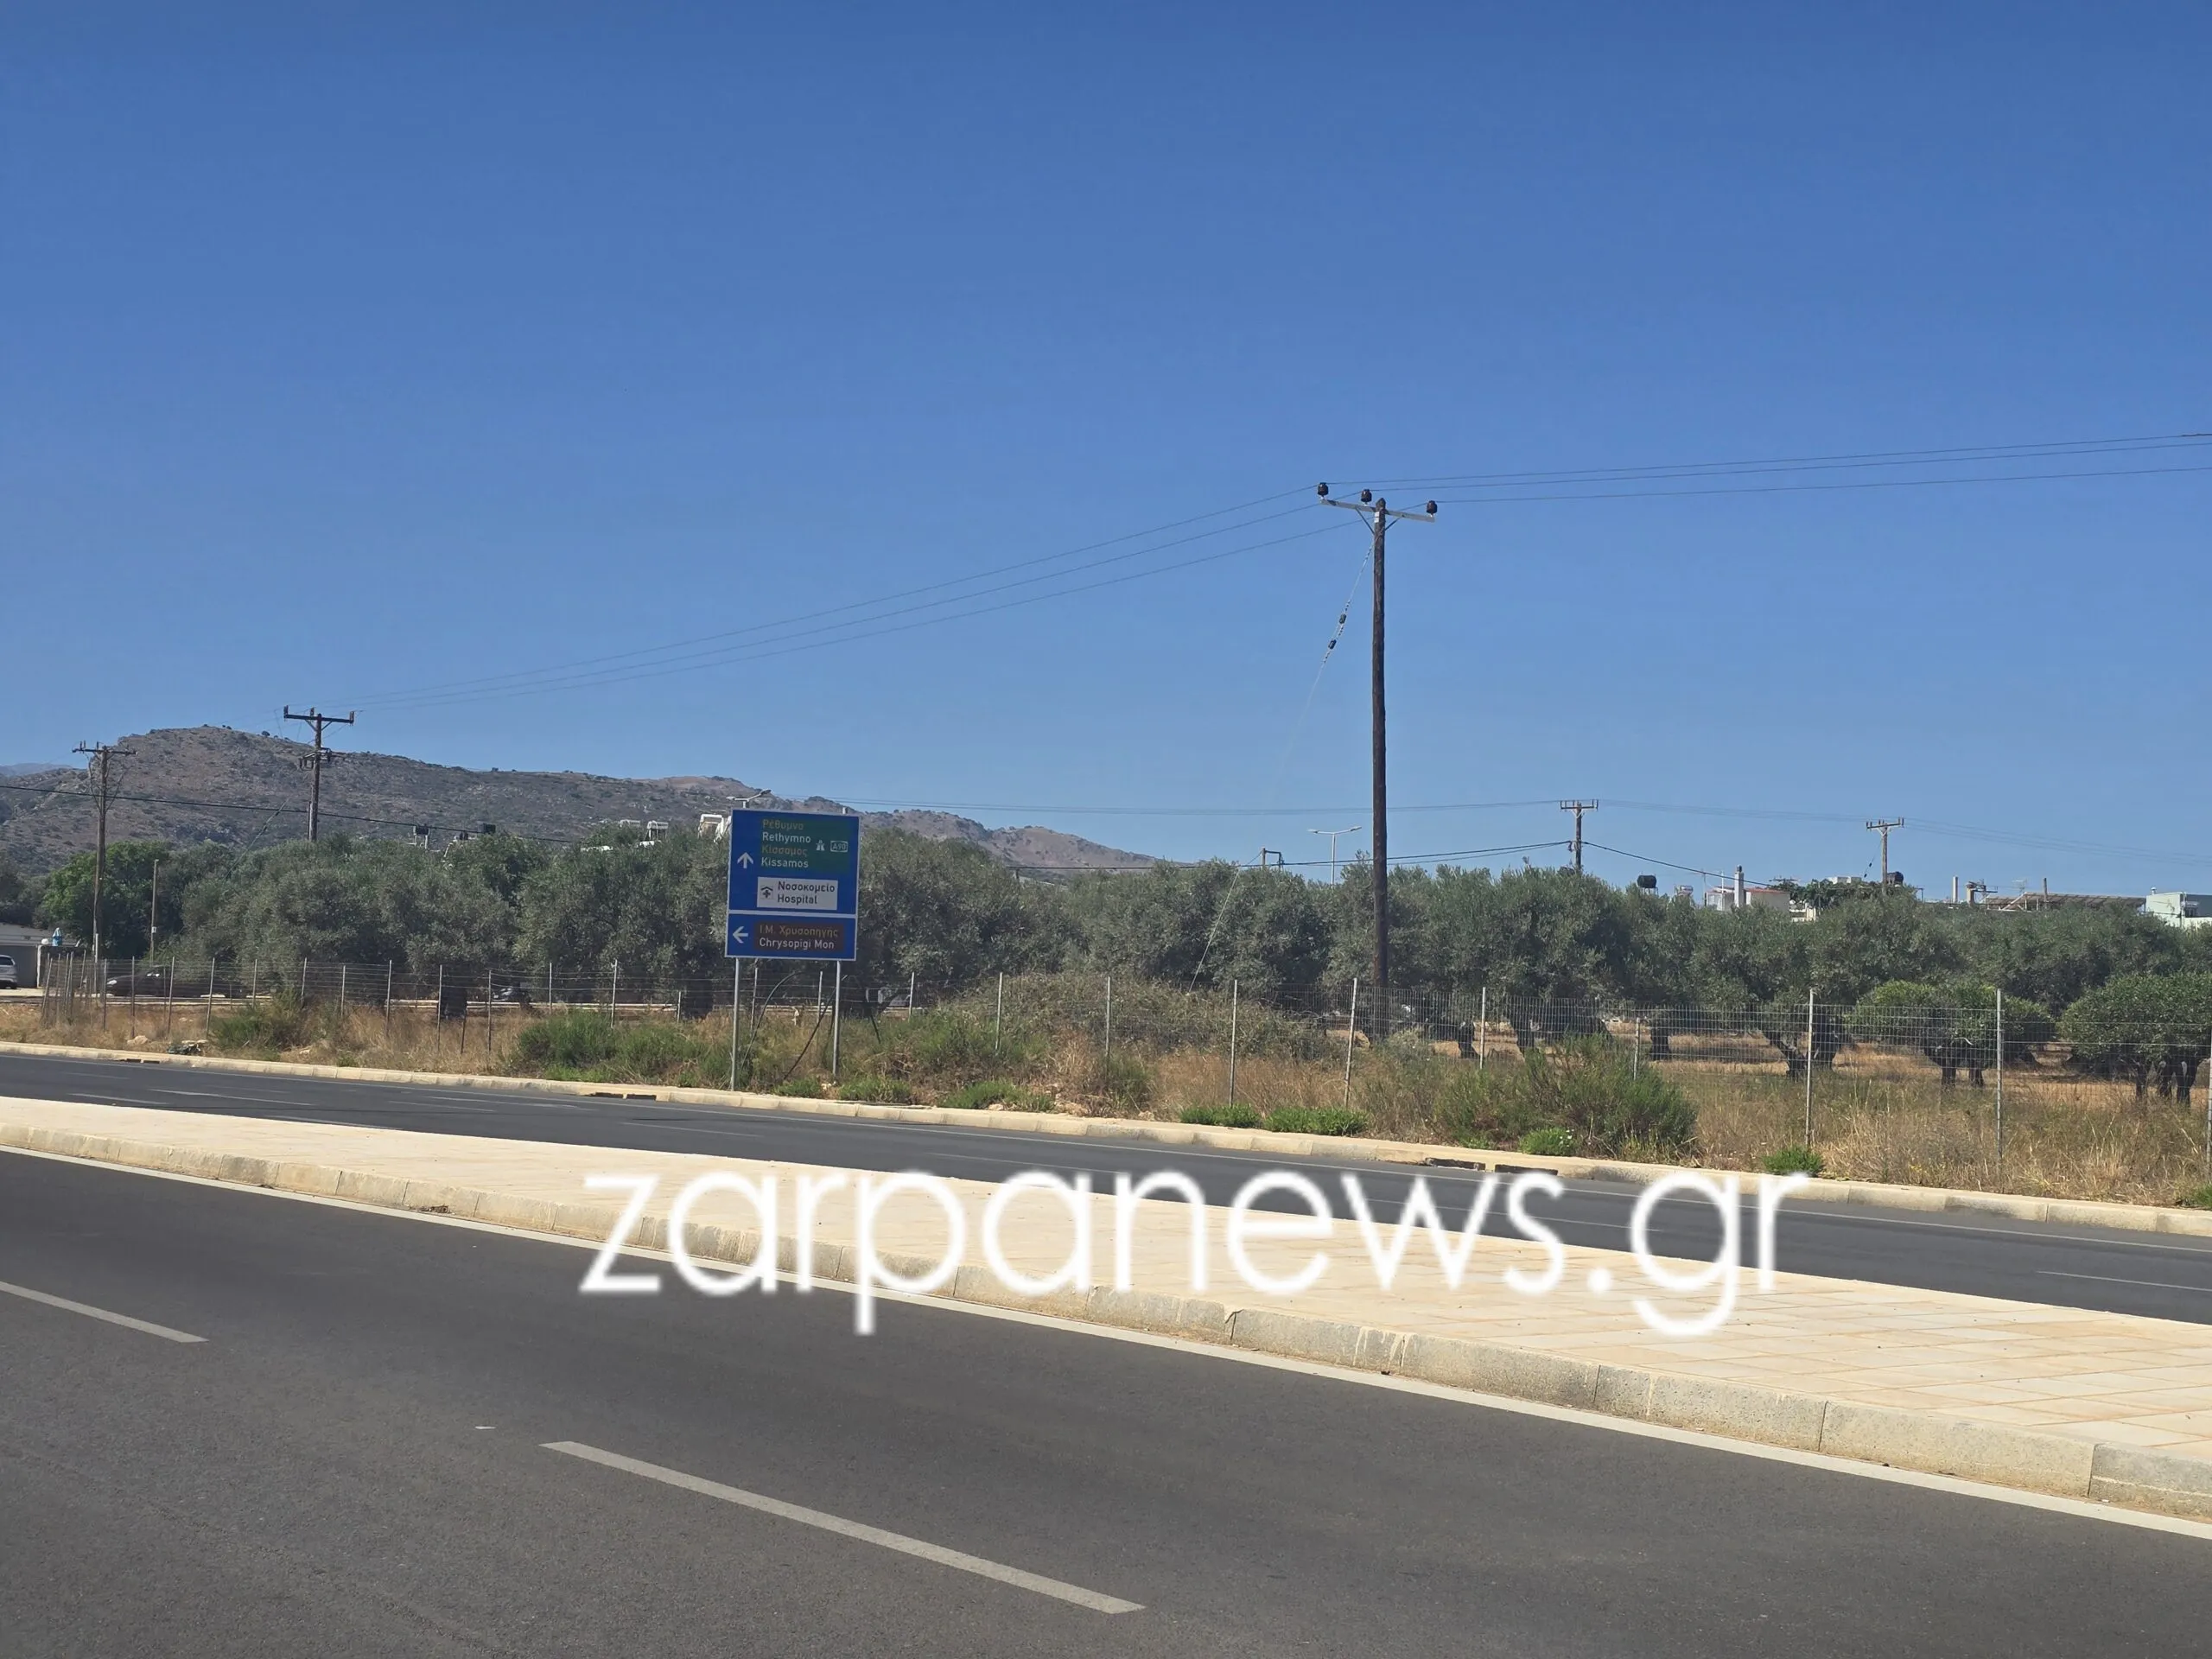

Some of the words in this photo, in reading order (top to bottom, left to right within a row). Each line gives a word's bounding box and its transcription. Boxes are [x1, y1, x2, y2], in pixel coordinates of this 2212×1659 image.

[762, 819, 804, 831] Ρέθυμνο
[762, 831, 811, 844] Rethymno
[761, 857, 810, 868] Kissamos
[778, 880, 836, 893] Νοσοκομείο
[777, 893, 818, 906] Hospital
[760, 938, 811, 950] Chrysopigi
[814, 939, 835, 950] Mon
